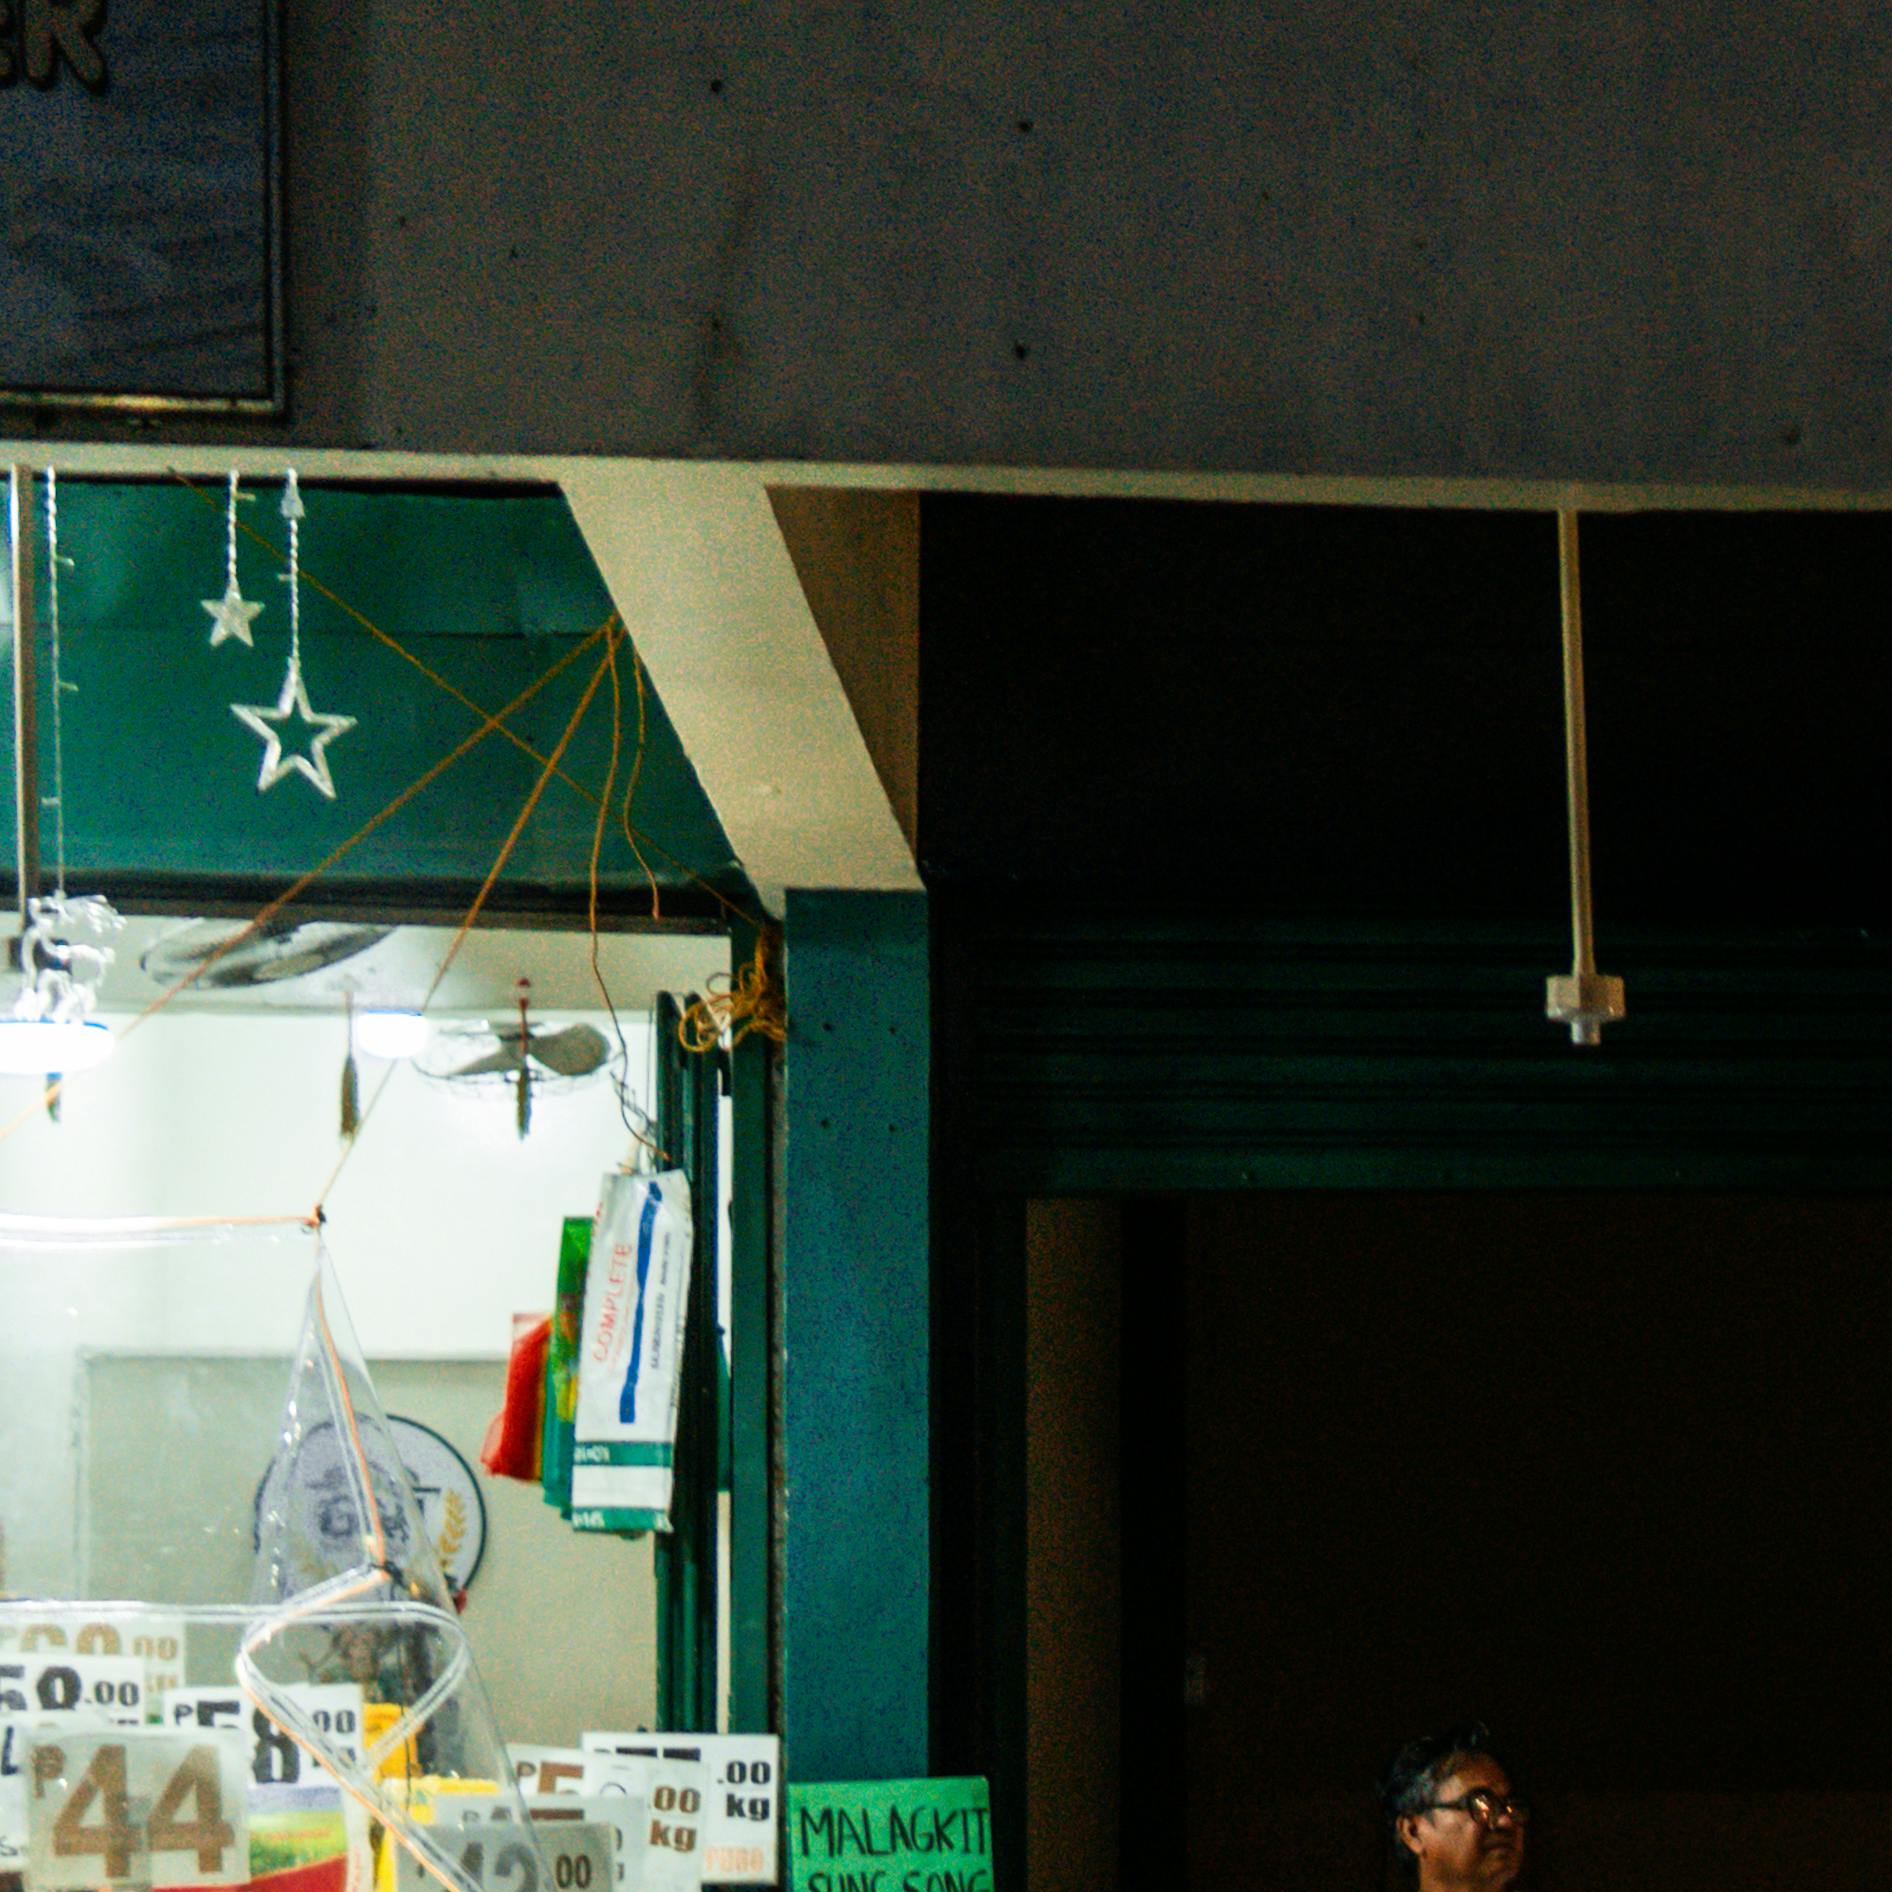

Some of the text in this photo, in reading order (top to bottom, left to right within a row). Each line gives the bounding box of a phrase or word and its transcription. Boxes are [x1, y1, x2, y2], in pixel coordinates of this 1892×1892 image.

[592, 1243, 634, 1362] COMPLETE
[726, 1792, 770, 1822] kg
[649, 1819, 697, 1853] kg
[801, 1806, 989, 1859] MALAGKIT
